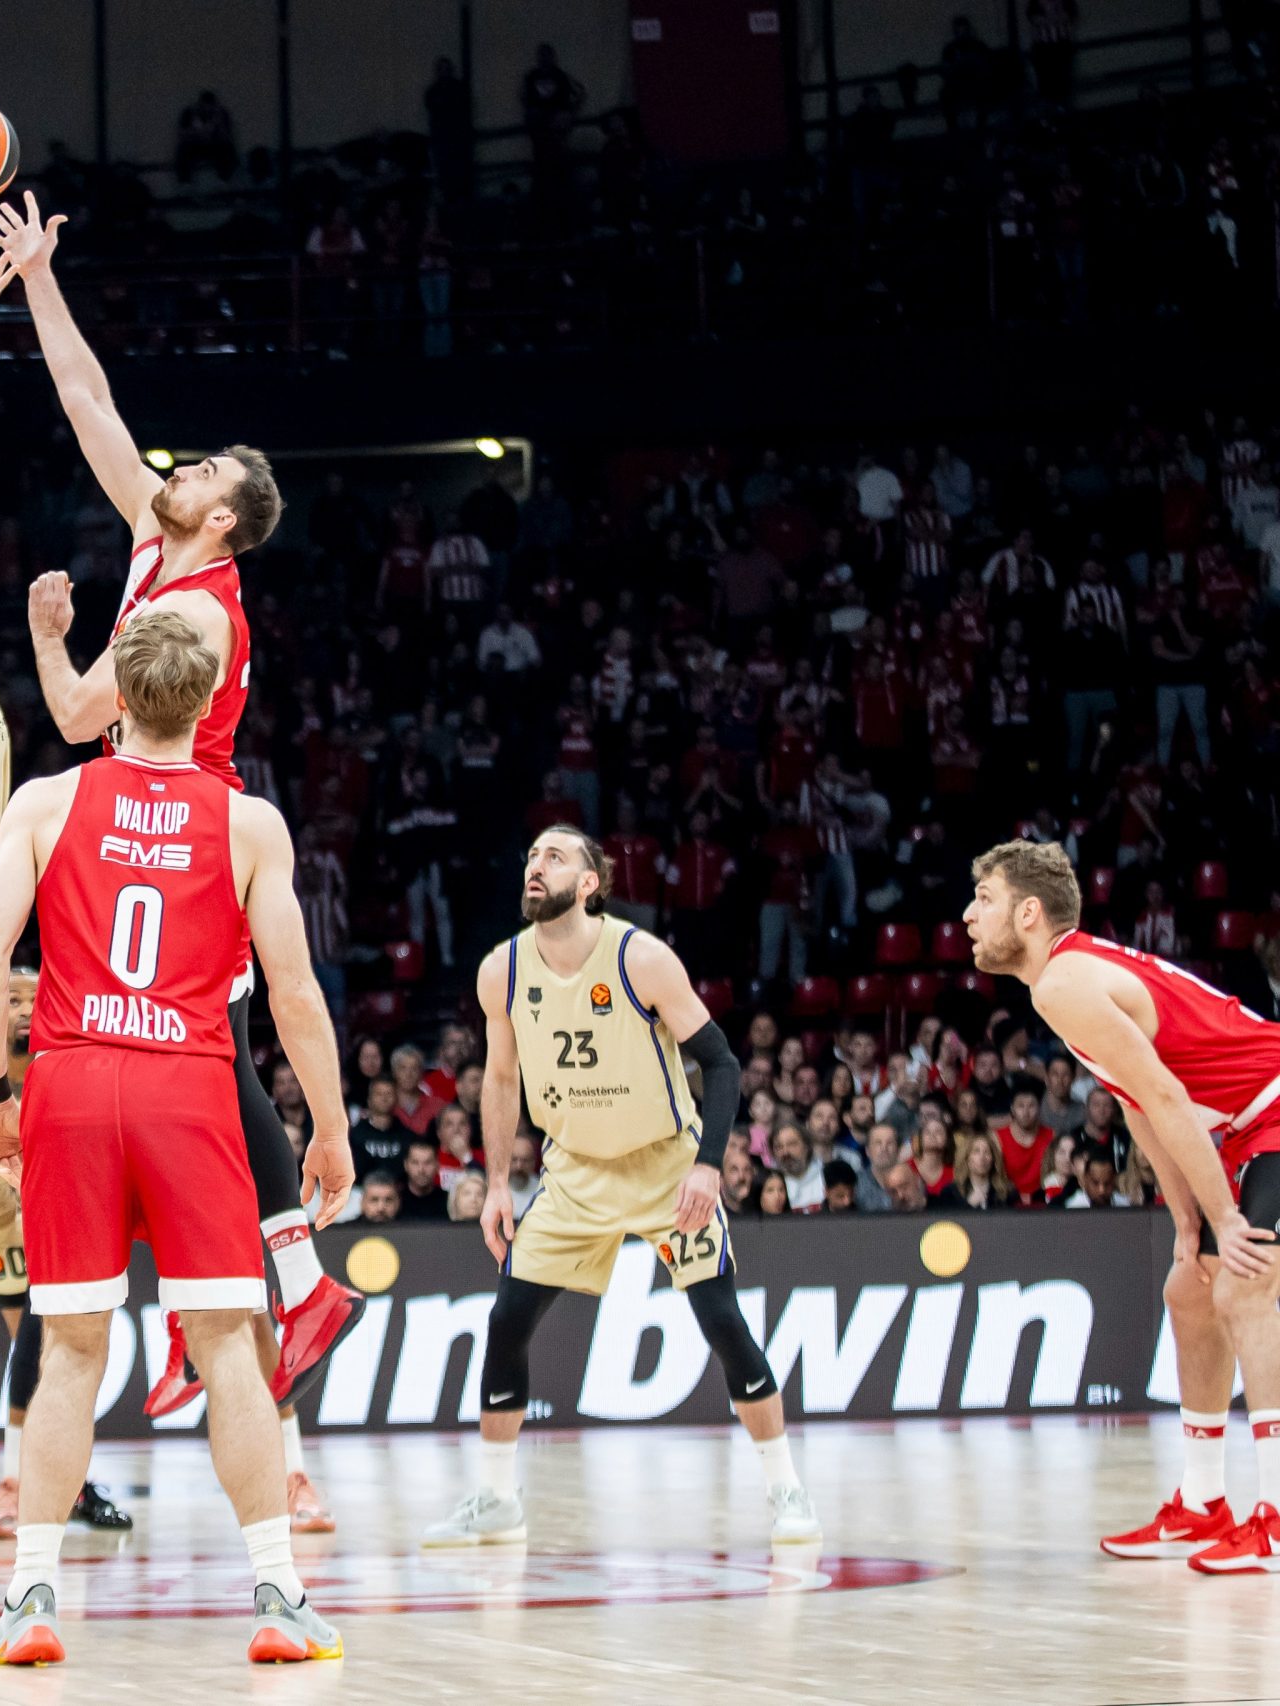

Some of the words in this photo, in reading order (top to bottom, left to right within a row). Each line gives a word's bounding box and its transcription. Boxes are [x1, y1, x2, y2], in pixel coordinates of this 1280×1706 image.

[114, 794, 190, 835] WALKUP
[100, 835, 192, 869] FMS
[108, 883, 164, 990] 0
[82, 994, 187, 1043] PIRAEUS
[552, 1030, 599, 1069] 23
[269, 1229, 305, 1250] GSA
[576, 1219, 1095, 1420] bwin
